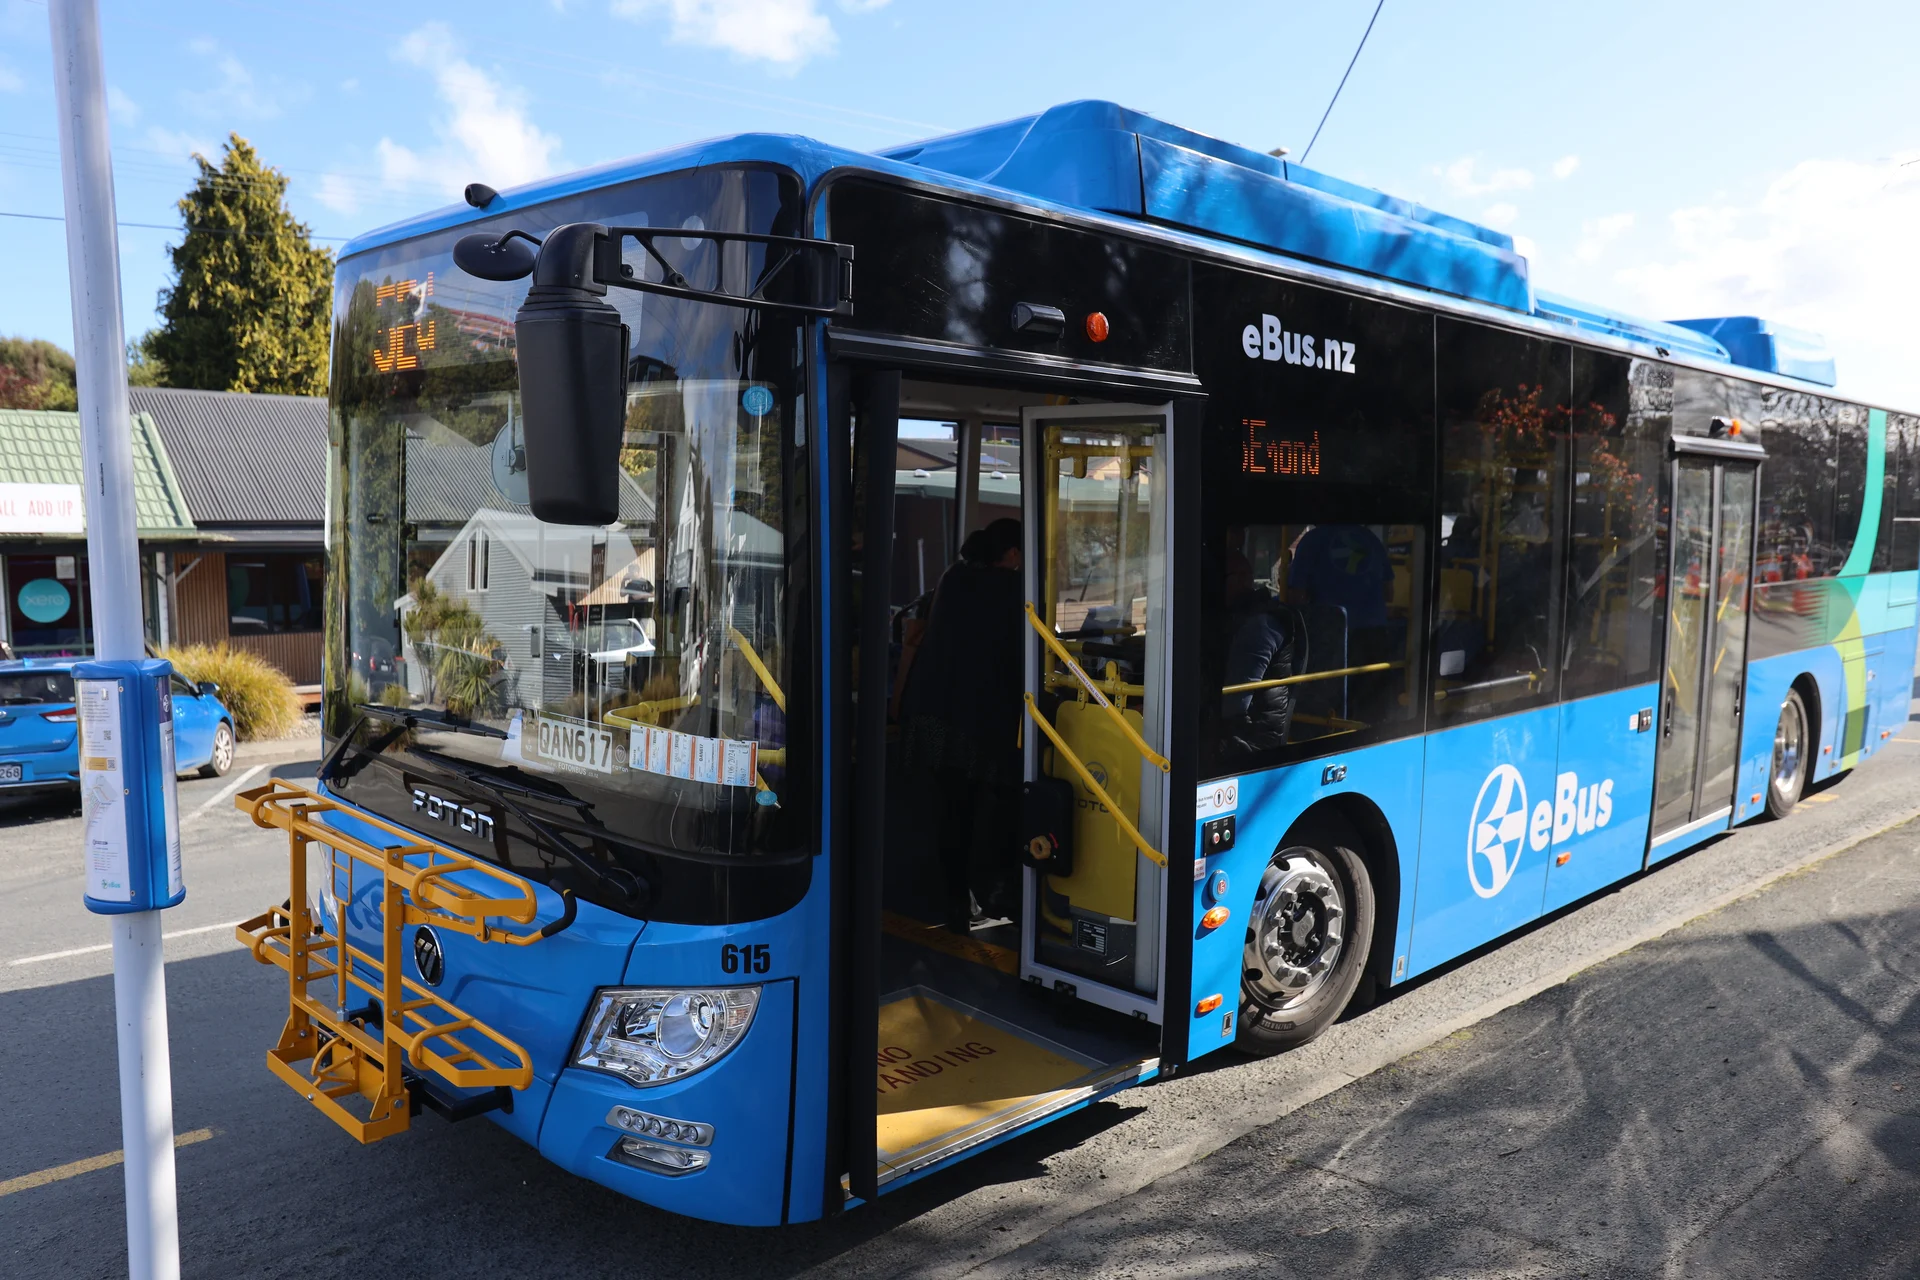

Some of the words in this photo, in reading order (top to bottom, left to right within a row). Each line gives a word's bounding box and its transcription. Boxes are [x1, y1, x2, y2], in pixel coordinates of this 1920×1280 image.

[1242, 313, 1356, 374] eBus.nz
[28, 499, 53, 516] ADD
[57, 499, 73, 516] UP
[25, 594, 65, 606] xero
[540, 722, 611, 768] QAN617
[558, 762, 587, 776] FOTONBUS
[412, 789, 496, 843] FOTON
[1529, 771, 1614, 852] eBus
[721, 944, 771, 974] 615
[877, 1041, 996, 1093] ANDING
